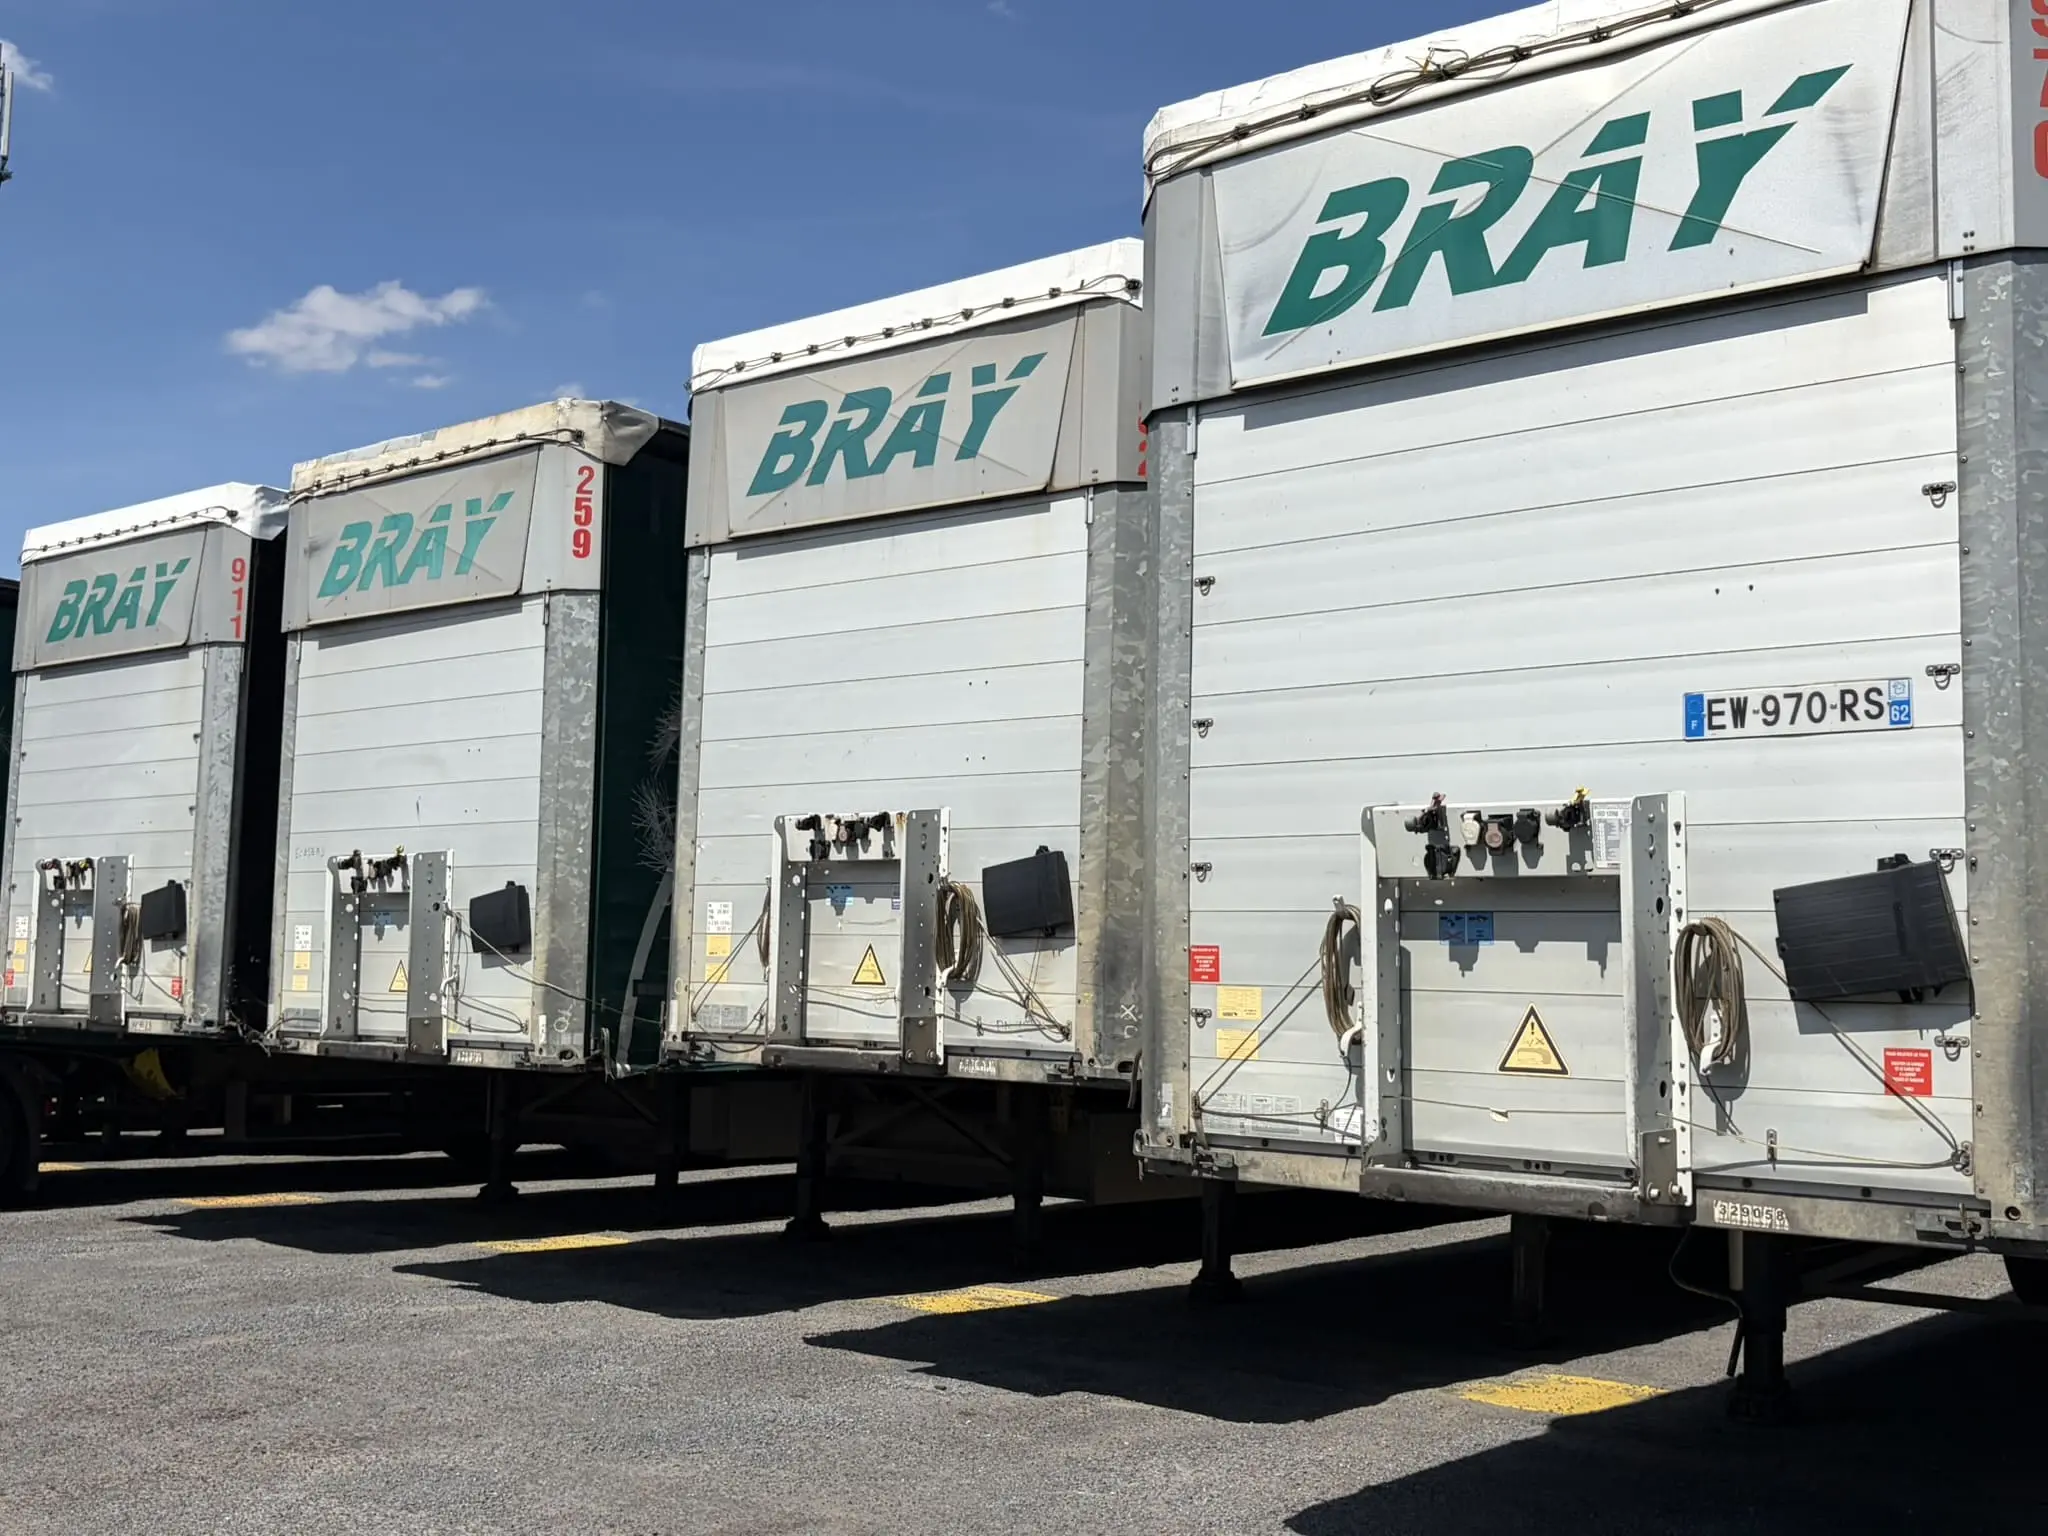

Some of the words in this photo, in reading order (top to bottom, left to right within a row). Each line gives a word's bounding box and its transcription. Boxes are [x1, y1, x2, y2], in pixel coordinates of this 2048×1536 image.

[1263, 65, 1851, 336] BRAY
[748, 353, 1045, 496] BRAY
[318, 491, 513, 598] BRAY
[572, 465, 595, 559] 259
[47, 558, 190, 643] BRAY
[230, 557, 247, 639] 911
[1691, 719, 1698, 730] F
[1706, 687, 1885, 731] EW-970-RS
[1891, 704, 1910, 722] 62
[1718, 1203, 1786, 1222] 329058
